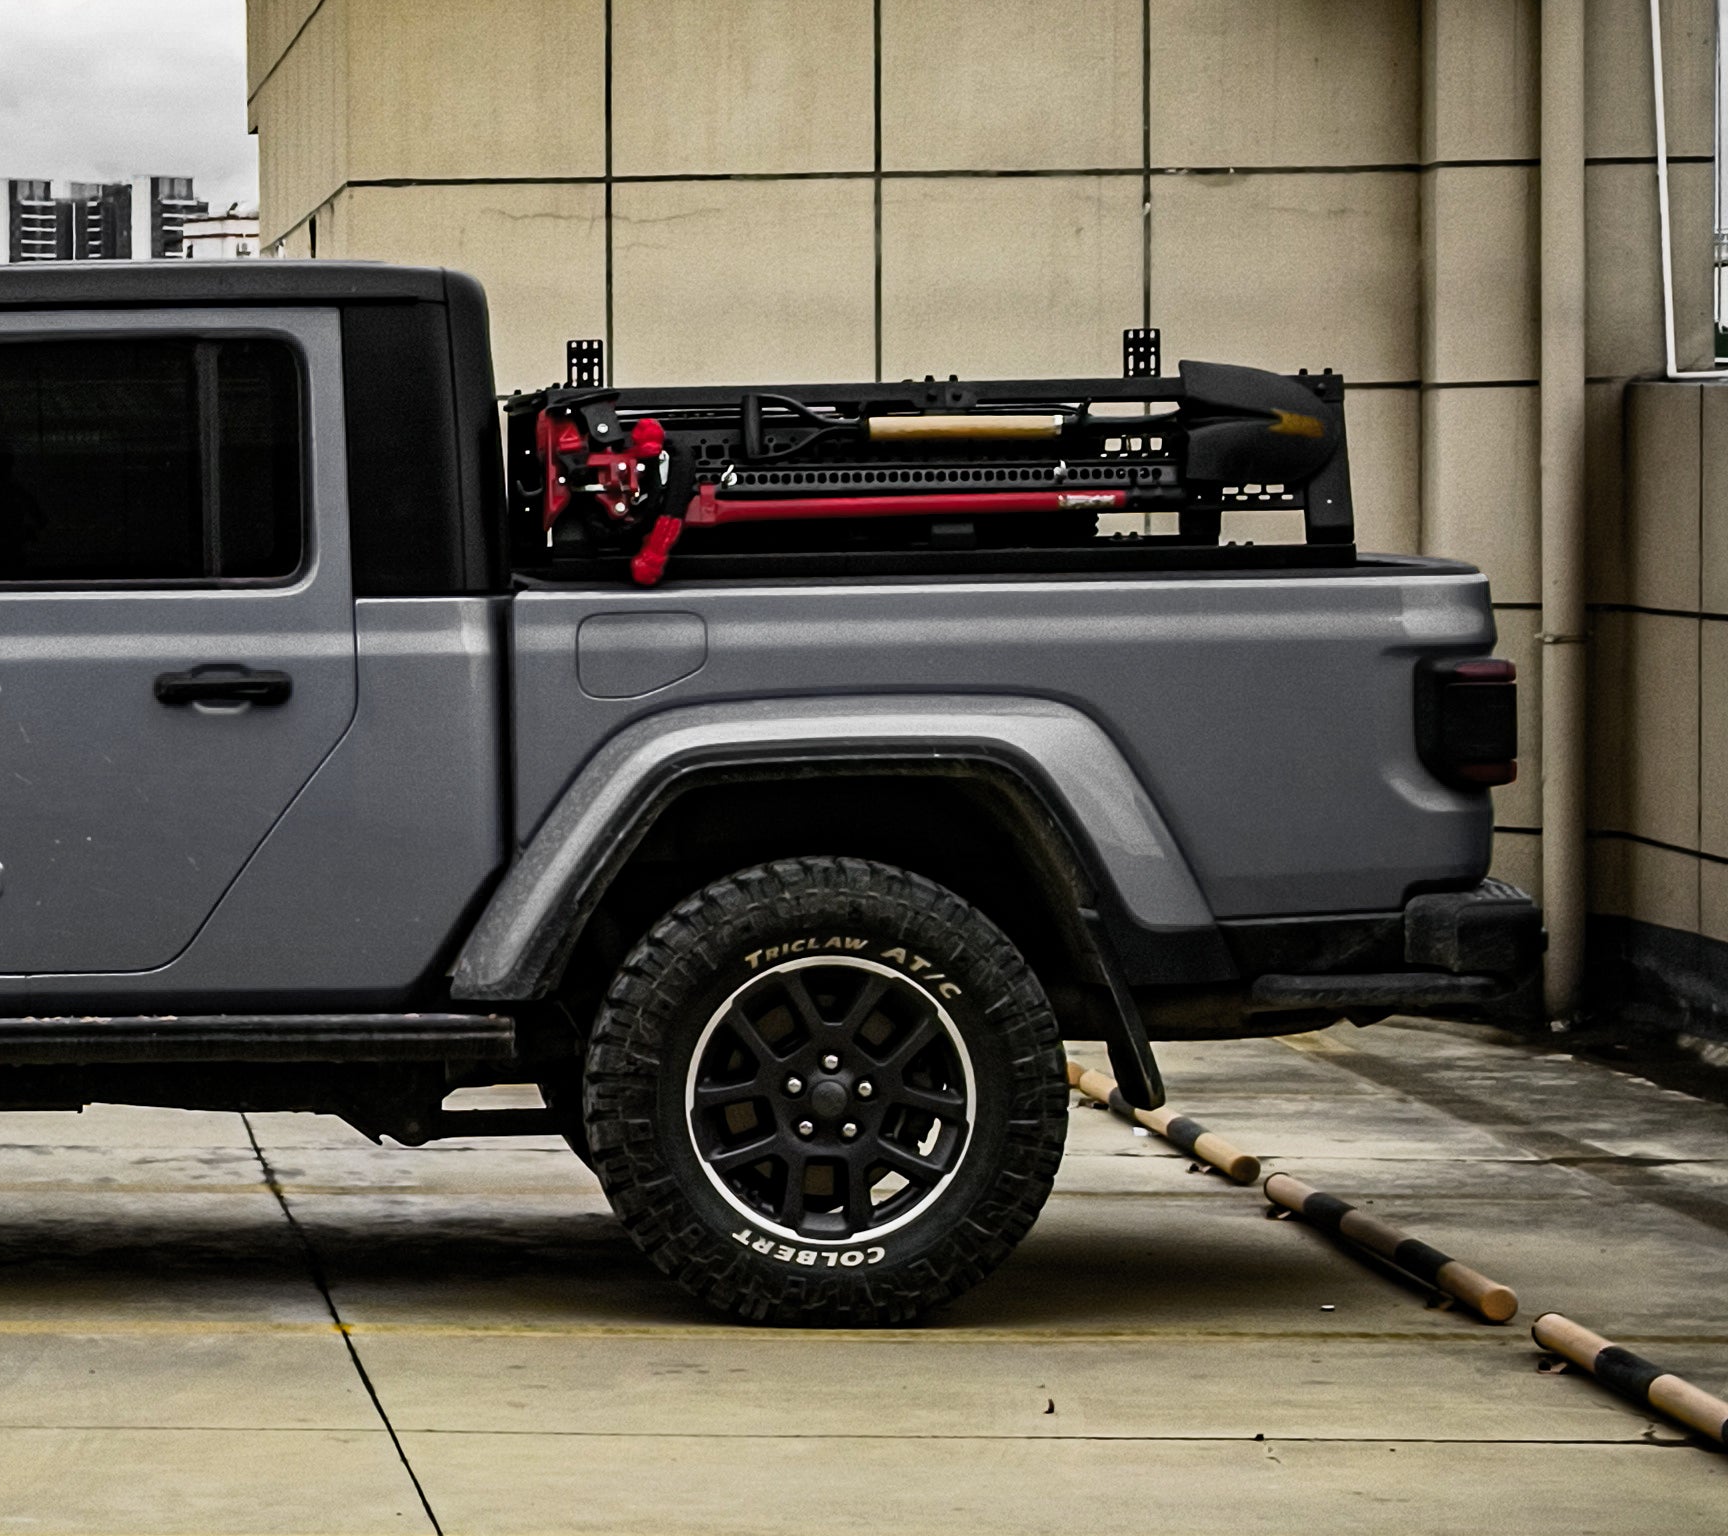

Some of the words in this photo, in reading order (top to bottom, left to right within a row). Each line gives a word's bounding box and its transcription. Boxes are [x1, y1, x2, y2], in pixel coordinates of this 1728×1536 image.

[744, 936, 869, 969] TRICLAW
[880, 946, 963, 1000] AT/C
[732, 1227, 886, 1268] COLBERT
